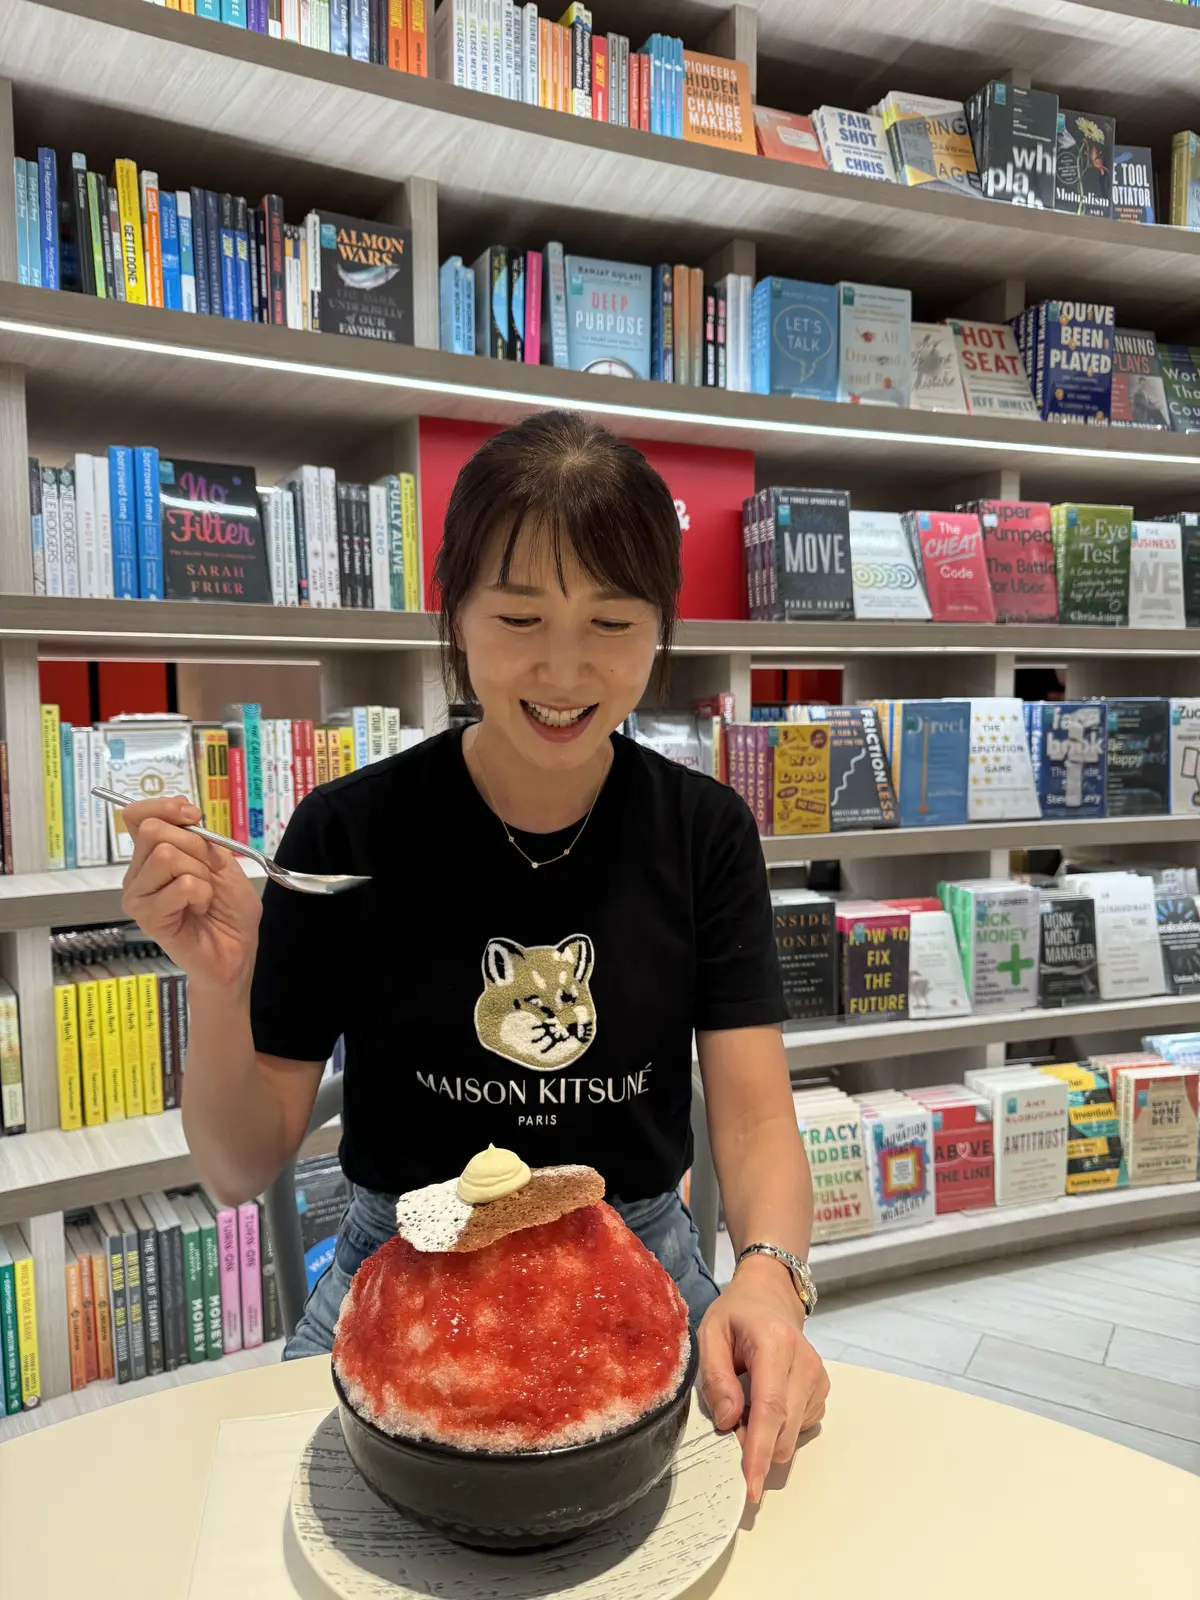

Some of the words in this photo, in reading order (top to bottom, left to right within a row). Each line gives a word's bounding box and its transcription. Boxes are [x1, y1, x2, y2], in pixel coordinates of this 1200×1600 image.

[575, 24, 584, 54] Frontier
[575, 55, 584, 88] Markets
[683, 60, 737, 81] PIONEERS
[686, 72, 740, 96] HIDDEN
[686, 86, 740, 106] CHAMPIONS
[687, 96, 740, 118] CHANGE
[689, 112, 743, 133] MAKERS
[837, 111, 873, 131] FAIR
[839, 128, 877, 148] SHOT
[845, 157, 885, 175] CHRIS
[939, 163, 982, 191] AGE
[1121, 162, 1150, 189] TOOL
[44, 170, 53, 208] Reputation
[988, 161, 1029, 197] pla
[1056, 186, 1110, 208] Mutualism
[1112, 185, 1151, 207] OTIATOR
[45, 209, 53, 242] Economy
[124, 225, 134, 243] GET
[126, 245, 135, 254] IT
[337, 227, 405, 255] ALMON
[337, 243, 394, 267] WARS
[127, 255, 137, 284] DONE
[591, 291, 629, 312] DEEP
[358, 316, 387, 328] OUR
[575, 310, 645, 336] PURPOSE
[1052, 300, 1115, 326] YOU'VE
[338, 322, 396, 342] FAVORITE
[785, 315, 823, 335] LET'S
[787, 333, 821, 353] TALK
[960, 325, 1007, 350] HOT
[1060, 325, 1104, 349] BEEN
[1113, 334, 1156, 358] NNING
[961, 349, 1020, 377] SEAT
[1050, 348, 1112, 375] PLAYED
[1047, 412, 1085, 426] ADRIAN
[1169, 400, 1200, 418] Cou
[117, 450, 128, 497] borrowed
[143, 451, 154, 498] borrowed
[180, 471, 229, 505] No
[118, 496, 128, 520] time
[144, 497, 153, 521] time
[390, 479, 402, 527] FULLY
[981, 503, 1031, 523] Super
[46, 510, 59, 564] RODGERS
[166, 507, 256, 547] Filter
[937, 520, 961, 535] The
[1094, 518, 1130, 545] Eye
[62, 511, 75, 566] RODGERS
[924, 531, 981, 559] CHEAT
[392, 529, 403, 575] ALIVE
[784, 531, 847, 575] MOVE
[1082, 542, 1121, 565] Test
[185, 562, 245, 579] SARAH
[940, 564, 974, 580] Code
[987, 557, 1013, 573] The
[190, 580, 245, 597] FRIER
[1009, 579, 1046, 595] Uber
[1132, 561, 1182, 596] WE
[724, 695, 734, 725] Binge
[371, 711, 381, 734] YOUR
[387, 715, 397, 737] YOUR
[983, 724, 1001, 732] THE
[372, 734, 382, 756] TURN
[388, 737, 398, 757] TURN
[971, 745, 1025, 753] EPUTATION
[746, 751, 754, 775] NO
[757, 751, 765, 776] NO
[860, 708, 896, 821] FRICTIONLESS
[984, 765, 1013, 774] GAME
[757, 779, 765, 822] LOGO
[776, 912, 831, 928] NSIDE
[1043, 911, 1073, 929] MONK
[890, 926, 909, 942] TO
[976, 928, 1029, 944] MONEY
[1044, 928, 1080, 946] MONEY
[866, 949, 891, 967] FIX
[1045, 943, 1095, 963] MANAGER
[864, 972, 893, 990] THE
[849, 993, 906, 1015] FUTURE
[416, 1069, 526, 1106] MAISON
[539, 1062, 653, 1105] KITSUNÉ
[518, 1114, 558, 1127] PARIS
[1003, 1127, 1066, 1156] ANTITRUST
[809, 1144, 862, 1164] IDDER
[814, 1169, 863, 1188] TRUCK
[936, 1168, 959, 1183] THE
[962, 1165, 992, 1181] LINE
[144, 1237, 155, 1254] THE
[146, 1255, 156, 1284] POWER
[147, 1286, 156, 1297] OF
[191, 1297, 206, 1354] MONEY
[208, 1294, 223, 1350] MONEY
